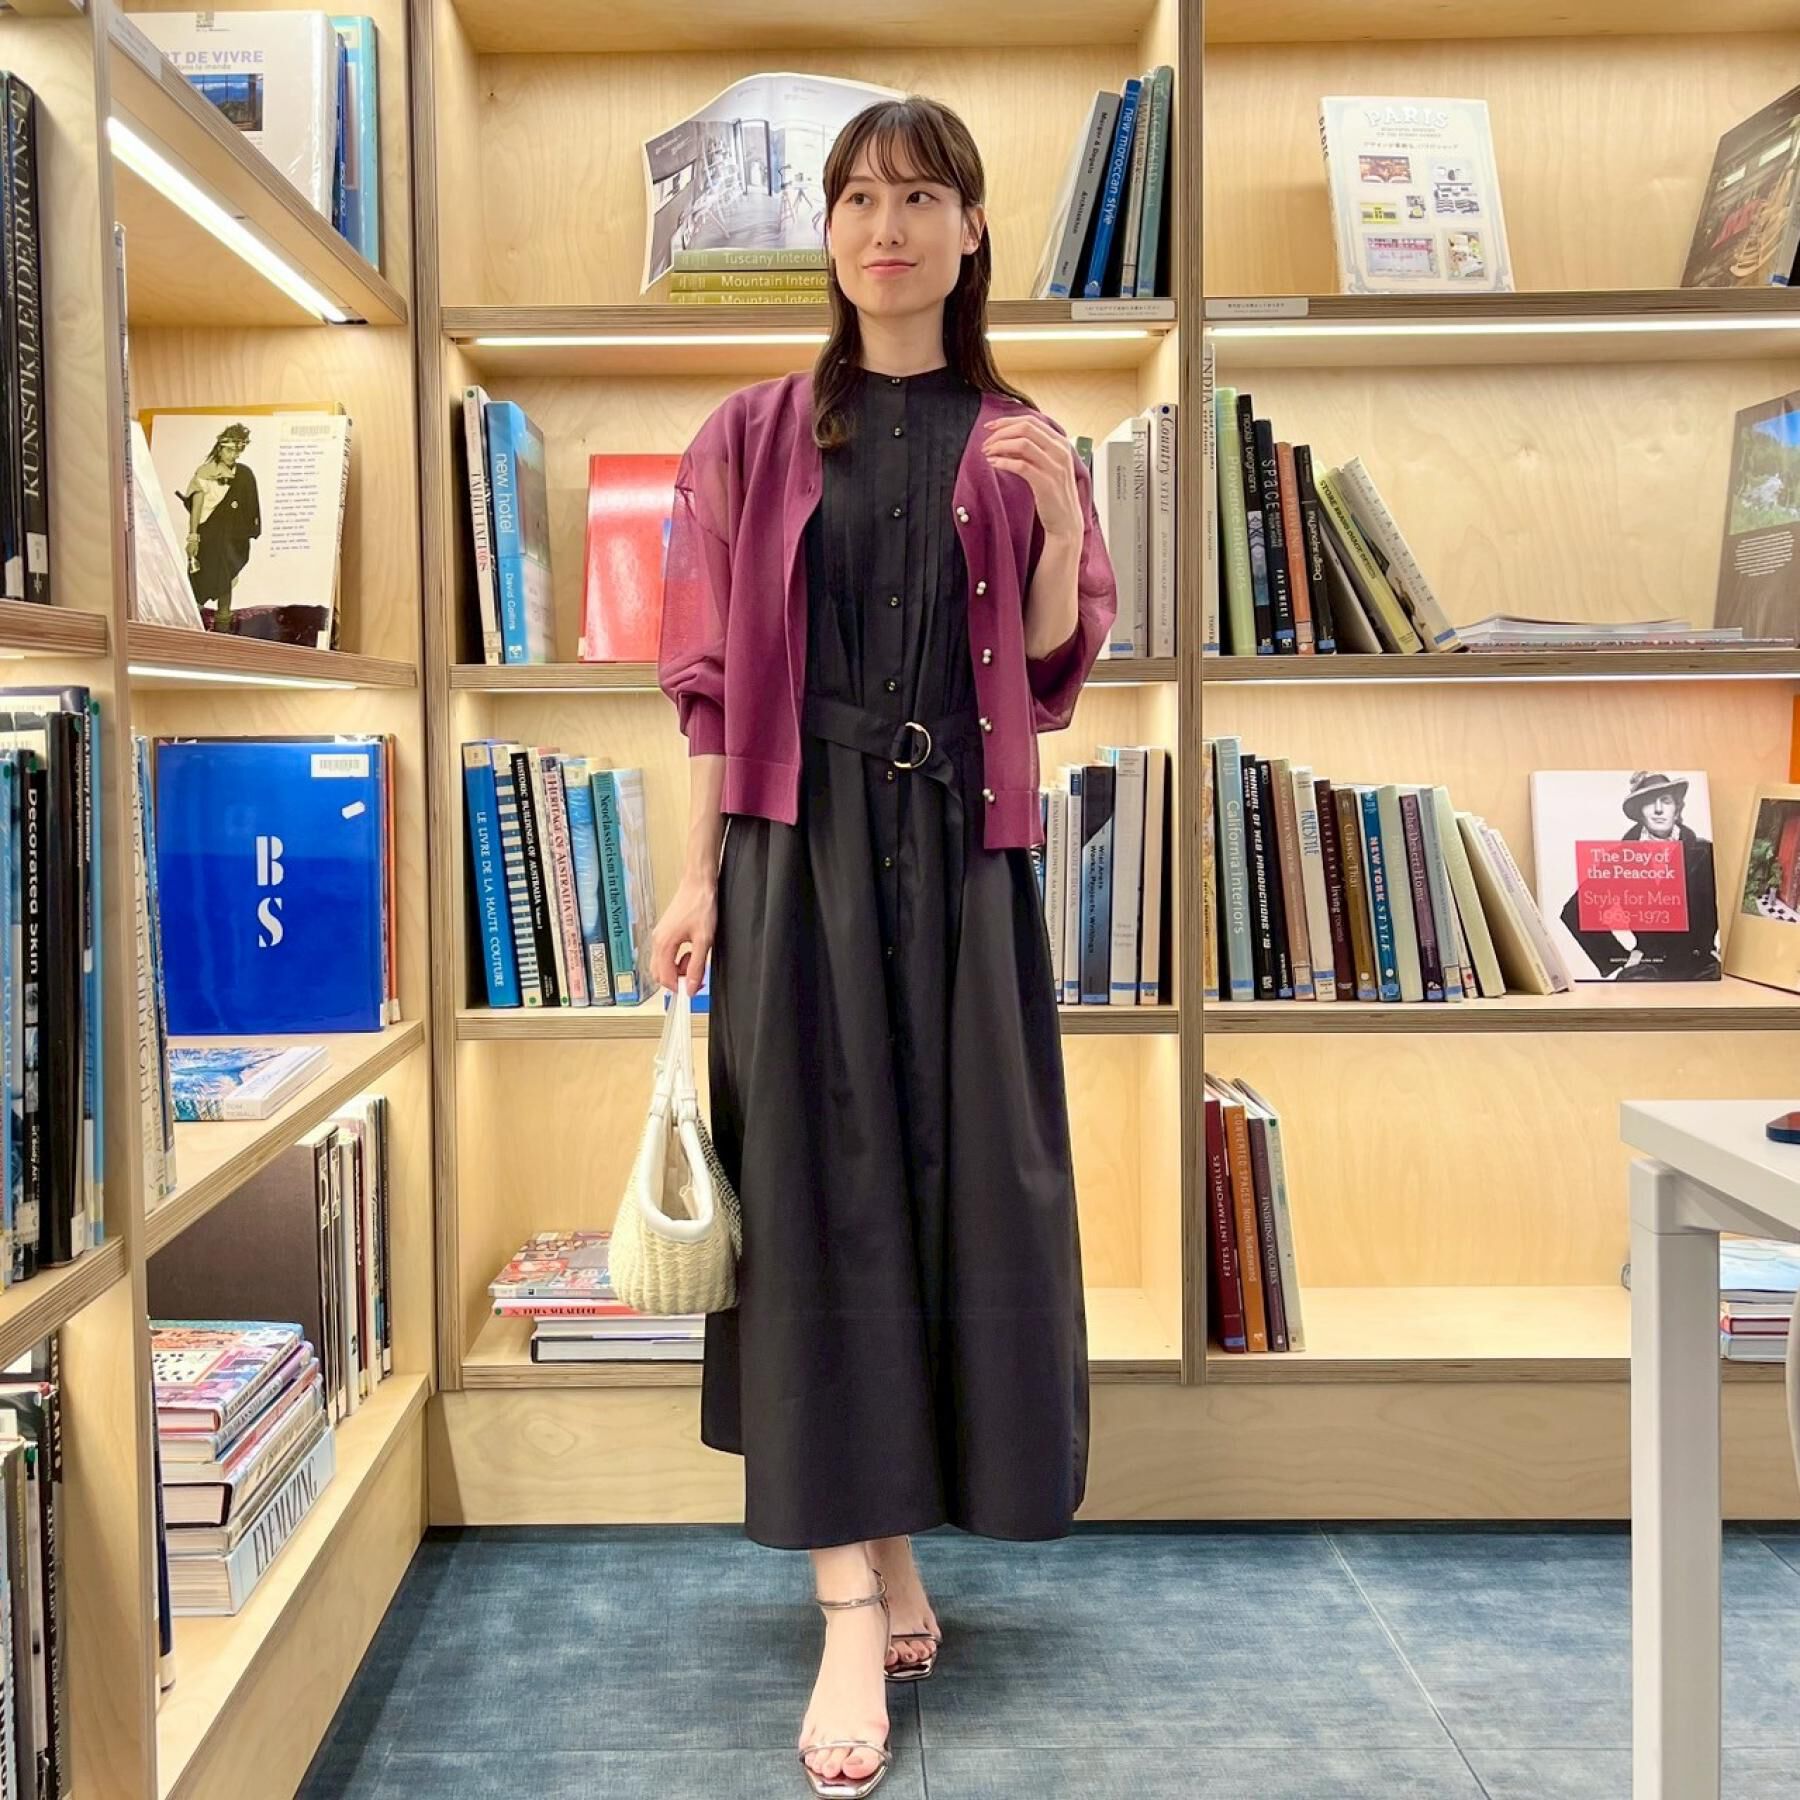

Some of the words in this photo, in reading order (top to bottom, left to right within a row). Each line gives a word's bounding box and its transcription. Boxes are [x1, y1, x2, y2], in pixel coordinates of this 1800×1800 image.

[186, 51, 208, 63] DE
[212, 50, 264, 63] VIVRE
[1121, 108, 1134, 132] new
[1363, 106, 1449, 129] PARIS
[1109, 135, 1129, 193] moroccan
[1103, 197, 1117, 225] style
[724, 252, 774, 267] Tuscany
[776, 251, 826, 265] Interior
[721, 276, 782, 287] Mountain
[785, 275, 827, 287] Interio
[721, 295, 782, 304] Mountain
[1159, 417, 1174, 475] Country
[496, 452, 509, 488] new
[1133, 431, 1147, 500] FLY-FISHING
[1245, 446, 1258, 493] bergmann
[1227, 455, 1241, 523] Provence
[1318, 478, 1338, 507] STORE
[1354, 463, 1400, 542] ITALIAN
[499, 493, 516, 534] hotel
[1286, 496, 1300, 560] PROVENCE
[1232, 526, 1247, 590] Interiors
[504, 573, 514, 593] David
[507, 594, 517, 630] Collins
[83, 754, 91, 792] History
[516, 758, 529, 798] HISTORIC
[1248, 767, 1258, 810] ANNUAL
[476, 811, 487, 824] LE
[522, 800, 536, 844] BUILDINGS
[548, 780, 565, 839] HERITAGE
[1251, 813, 1261, 827] OF
[1406, 811, 1417, 830] the
[28, 788, 39, 914] Decorated
[479, 828, 491, 857] LIVRE
[529, 845, 538, 857] OF
[556, 837, 565, 850] OF
[599, 794, 615, 874] Neoclassicism
[1225, 800, 1243, 871] California
[1253, 828, 1263, 850] WEB
[1301, 810, 1320, 857] FREESTYLE
[1344, 823, 1356, 861] Classic
[1370, 836, 1381, 865] NEW
[1408, 831, 1421, 867] Desert
[256, 835, 283, 887] B
[482, 861, 493, 874] DE
[1587, 866, 1610, 879] the
[1613, 865, 1675, 879] Peacock
[1590, 848, 1619, 863] The
[1623, 849, 1651, 865] Day
[1653, 848, 1670, 863] of
[484, 877, 495, 892] LA
[530, 860, 543, 905] AUSTRALIA
[557, 854, 573, 913] AUSTRALIA
[606, 876, 616, 887] in
[1255, 854, 1269, 930] PRODUCTIONS
[1349, 862, 1359, 888] Thai
[1373, 867, 1384, 902] YORK
[1412, 869, 1425, 902] Home
[486, 897, 498, 932] HAUTE
[607, 888, 620, 905] the
[1231, 872, 1246, 934] Interiors
[1331, 885, 1344, 914] living
[1584, 890, 1621, 907] Style
[1623, 890, 1643, 906] for
[1648, 892, 1681, 906] Men
[257, 897, 283, 948] S
[610, 904, 623, 938] North
[1377, 904, 1390, 953] STYLE
[489, 936, 505, 987] COUTURE
[3, 976, 12, 1089] REVEALED
[1233, 1113, 1247, 1166] CONVERTED
[1213, 1154, 1229, 1243] INTEMPORELLES
[1238, 1169, 1250, 1203] SPACES
[1261, 1195, 1275, 1243] FINISHING
[1222, 1247, 1232, 1277] FÊTES
[1265, 1244, 1279, 1285] TOUCHES
[253, 1456, 320, 1578] EYEMAZING
